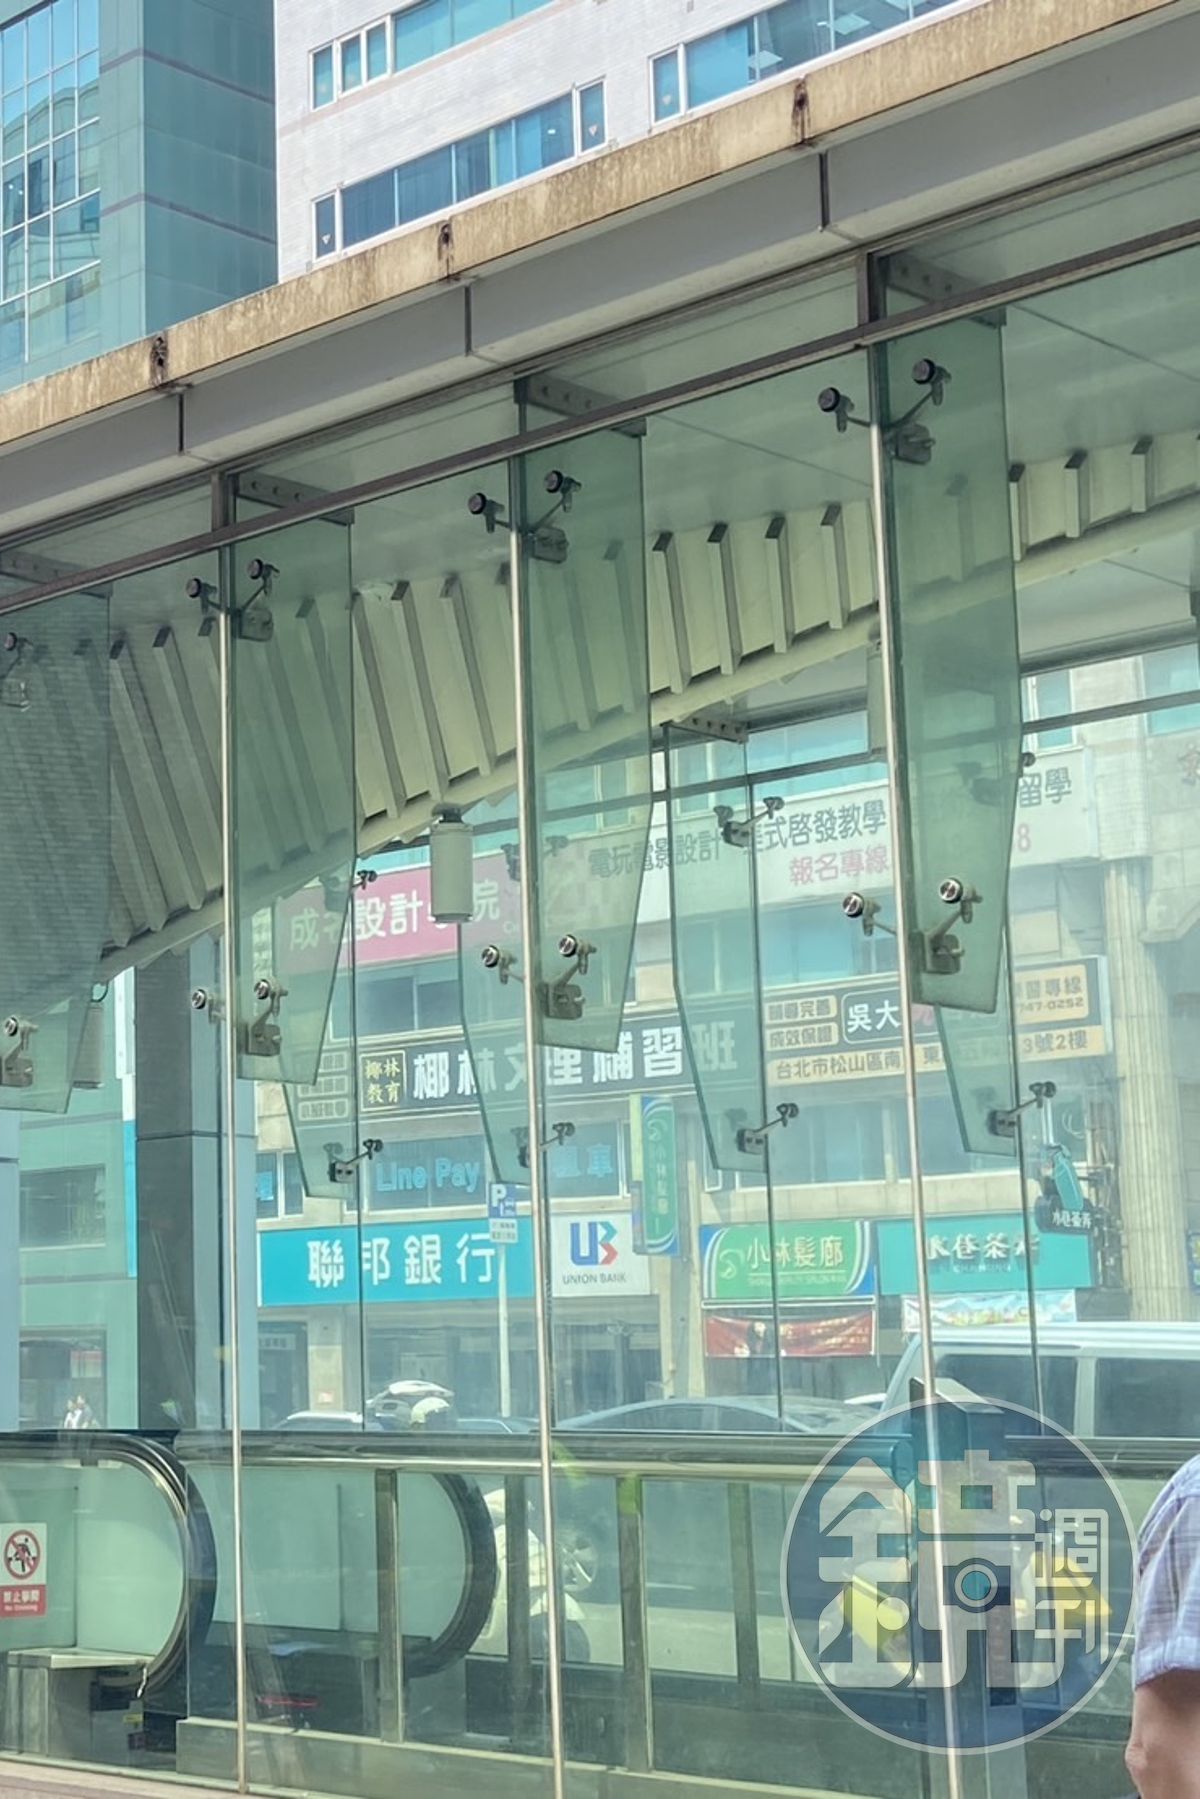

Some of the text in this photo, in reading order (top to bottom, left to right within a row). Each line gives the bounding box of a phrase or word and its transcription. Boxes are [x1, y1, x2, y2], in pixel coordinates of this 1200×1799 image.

[435, 1157, 481, 1193] Pay
[491, 1183, 507, 1208] P
[307, 1231, 496, 1288] 聯邦銀行
[562, 1273, 598, 1284] UNION
